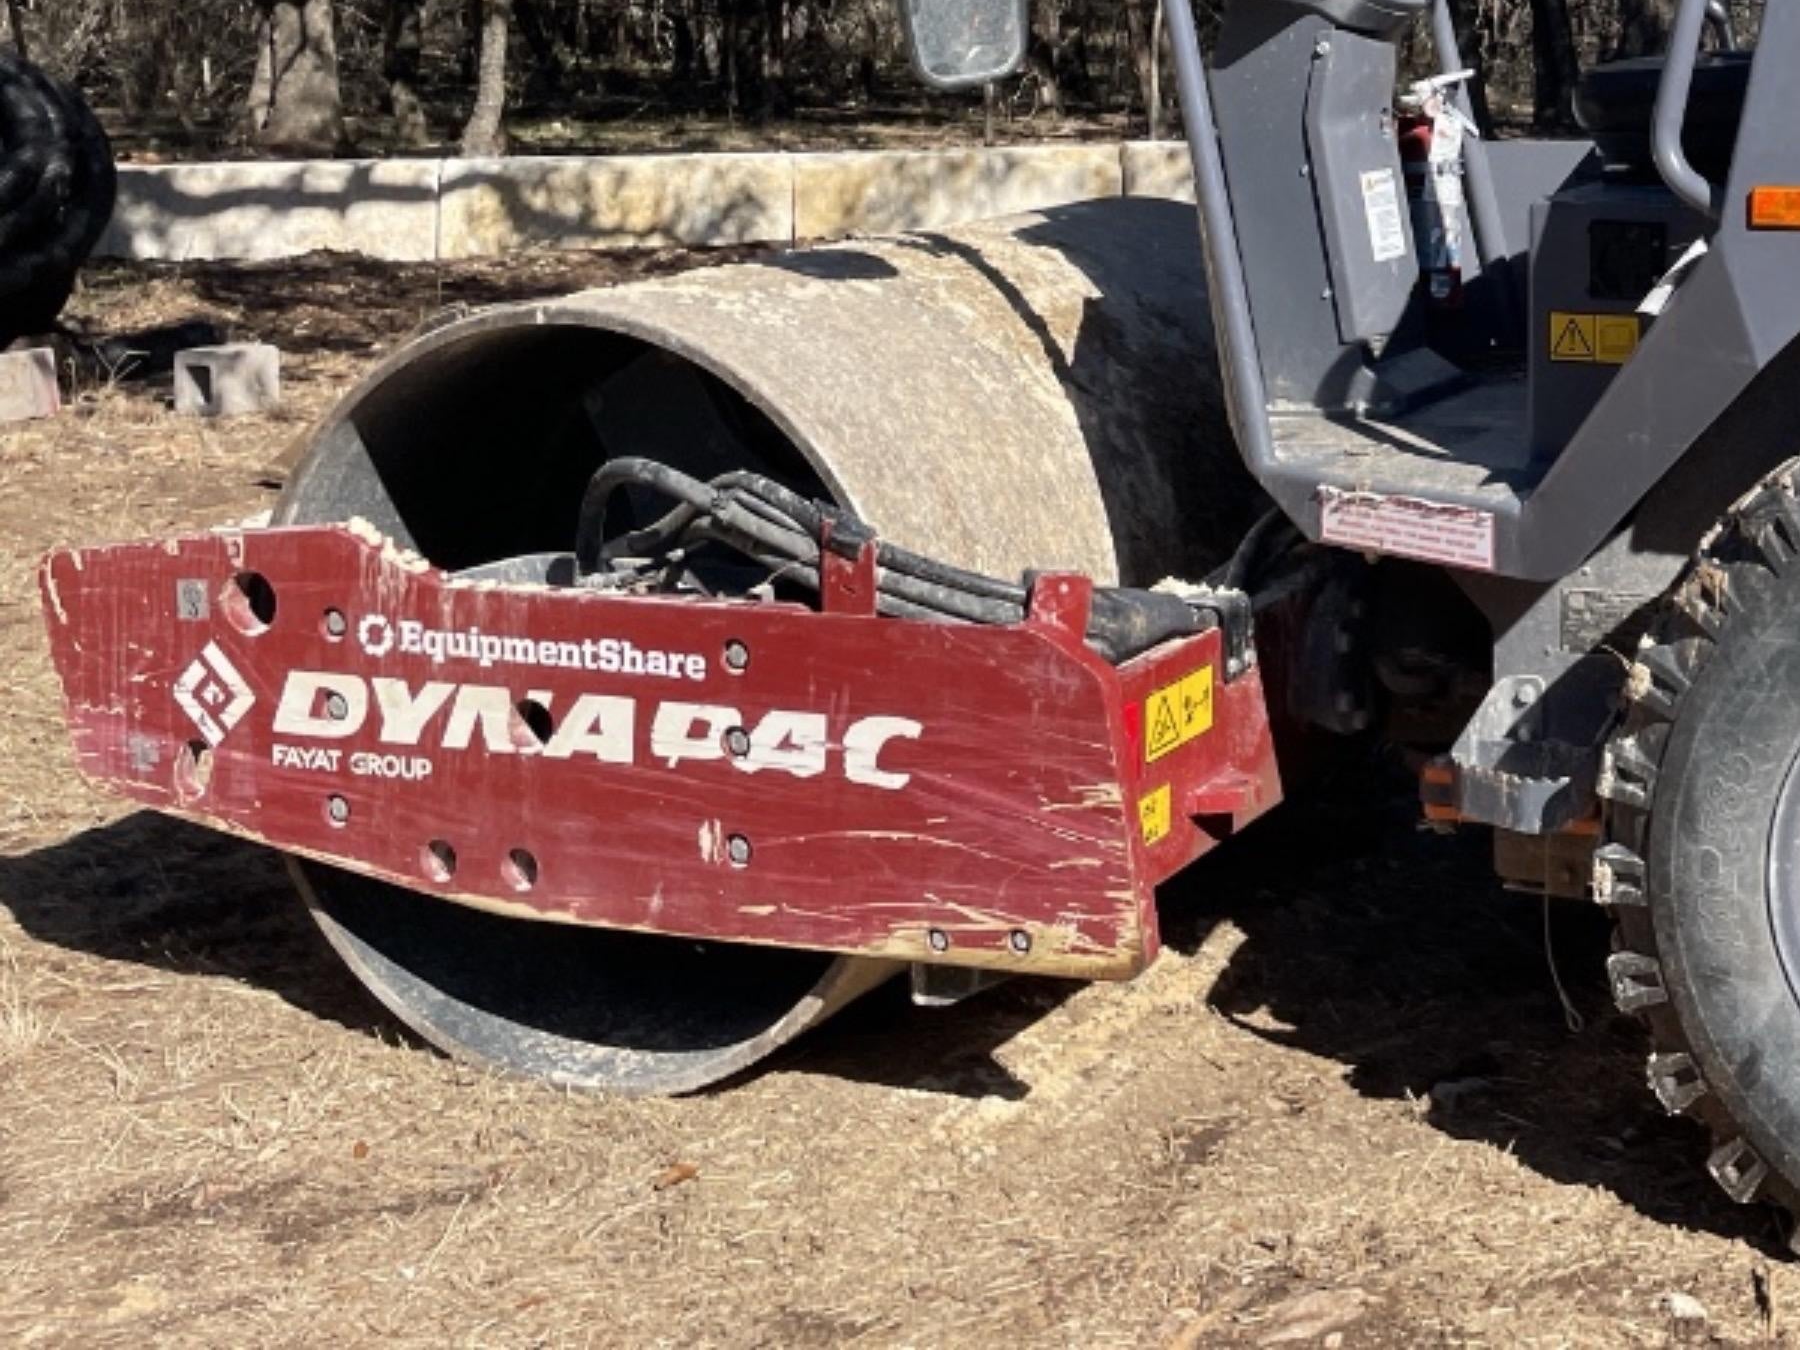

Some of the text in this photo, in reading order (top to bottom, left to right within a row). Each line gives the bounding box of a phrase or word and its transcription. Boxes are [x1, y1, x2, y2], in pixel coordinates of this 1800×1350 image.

[398, 619, 707, 681] EquipmentShare
[272, 669, 924, 790] DYNAPAC
[271, 743, 432, 780] FAYAT GROUP
